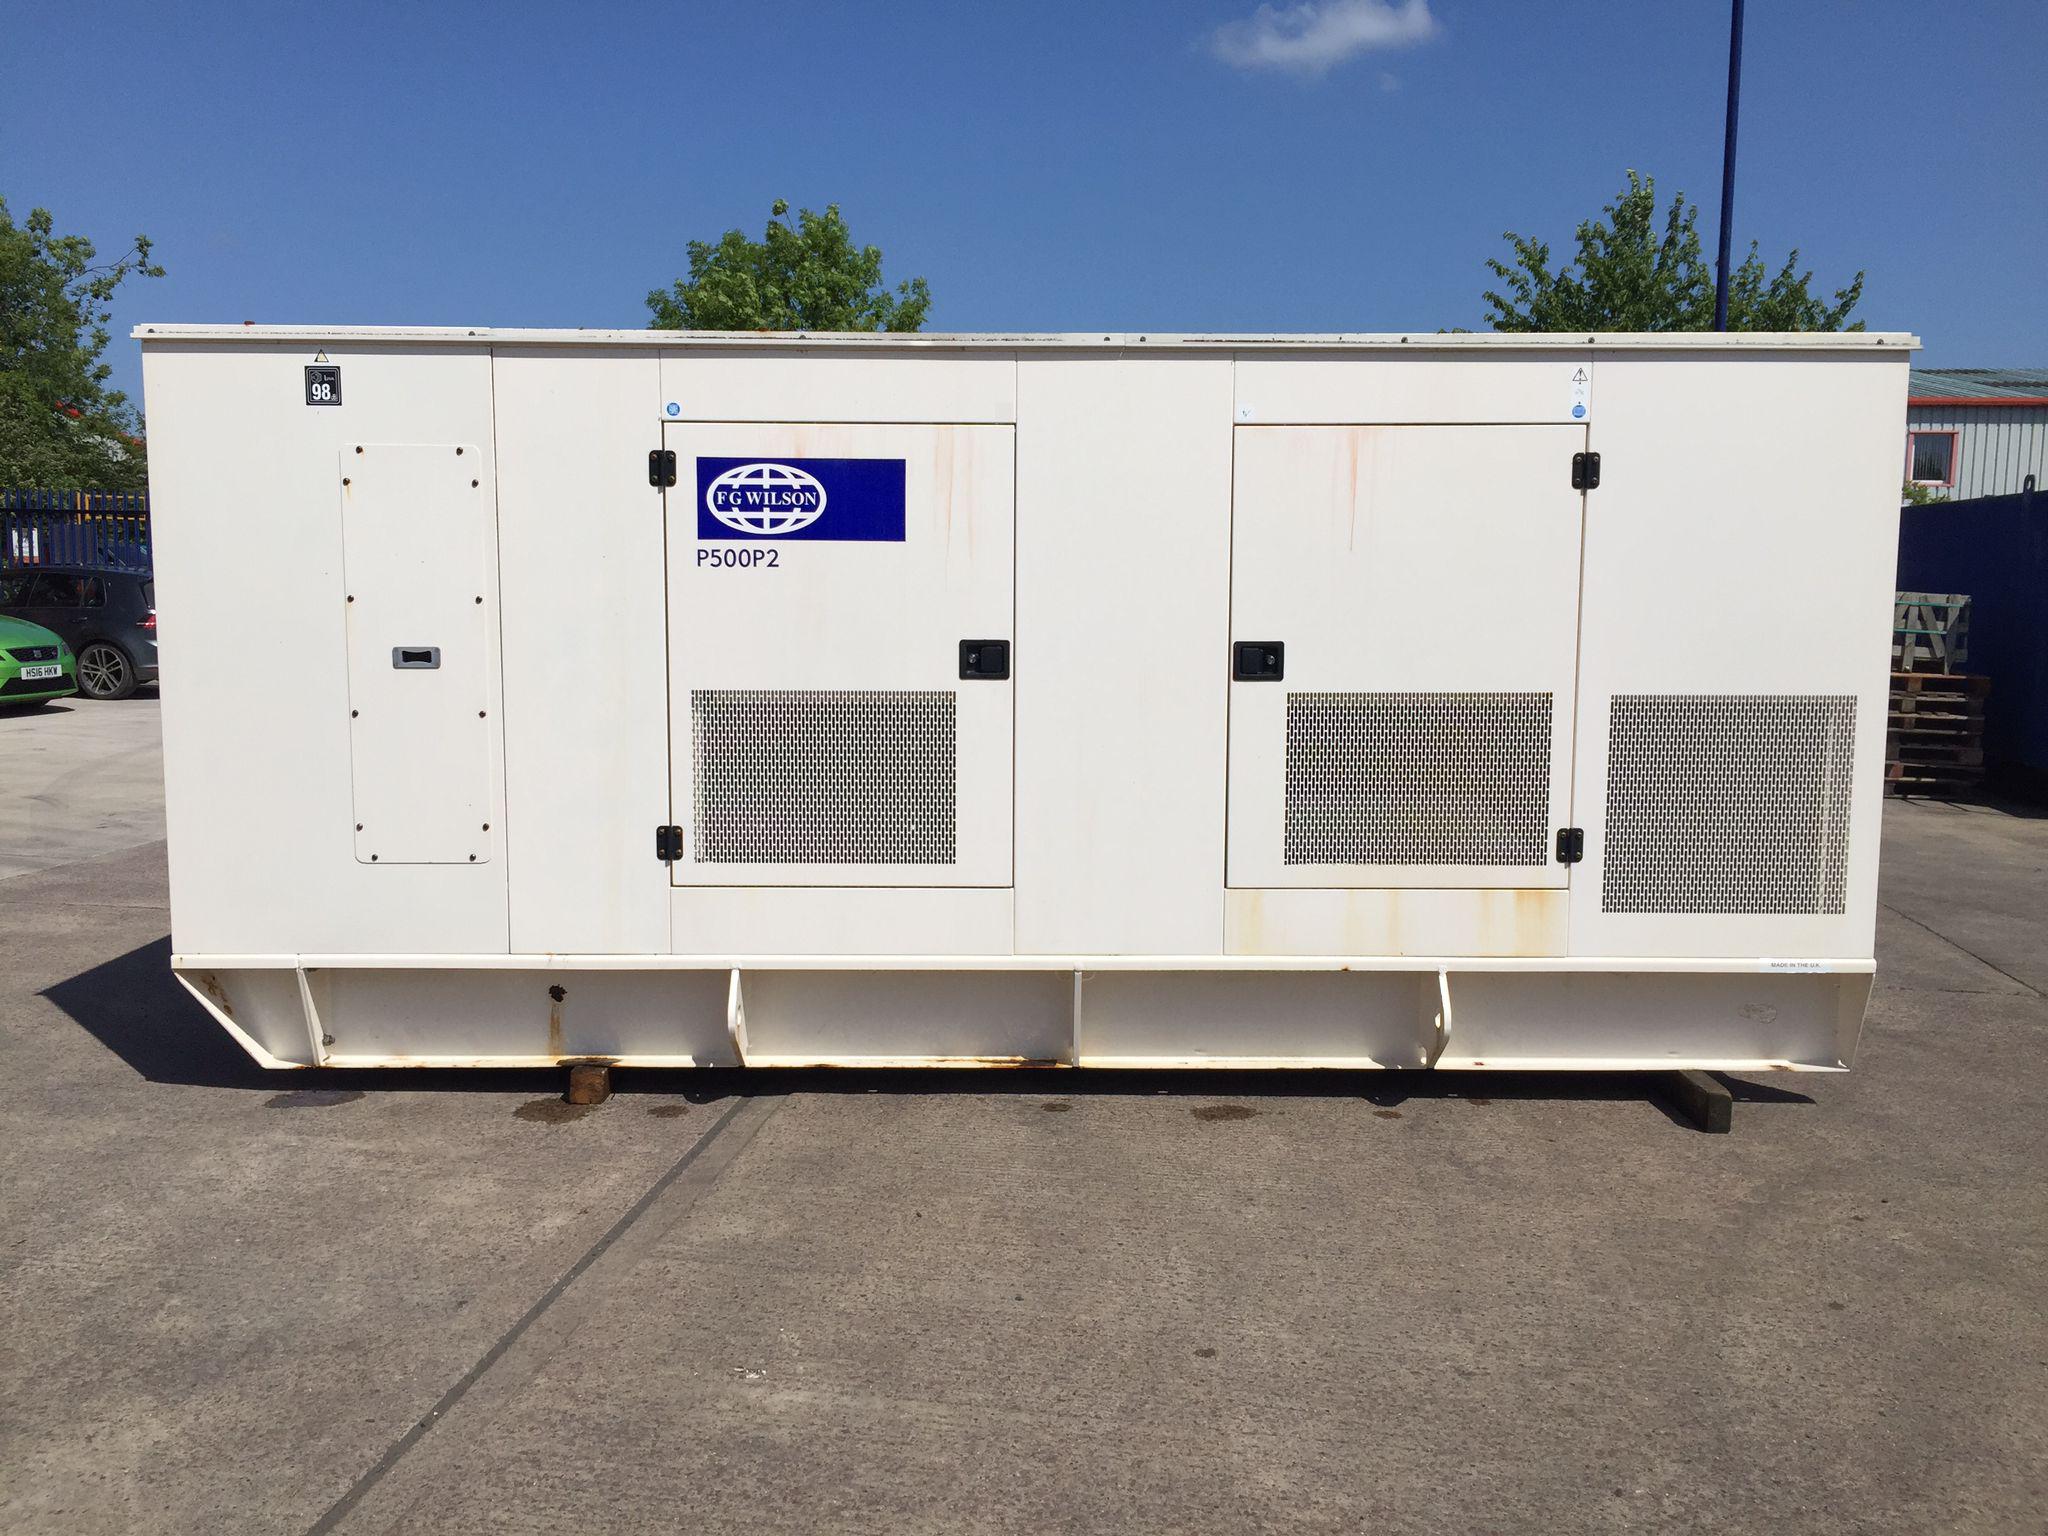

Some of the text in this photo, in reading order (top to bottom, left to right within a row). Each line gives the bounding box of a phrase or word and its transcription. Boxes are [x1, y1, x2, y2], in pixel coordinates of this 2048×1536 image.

[312, 383, 331, 400] 98
[717, 491, 818, 506] FG WILSON
[697, 548, 780, 568] P500P2
[26, 666, 58, 677] HS16 HKW
